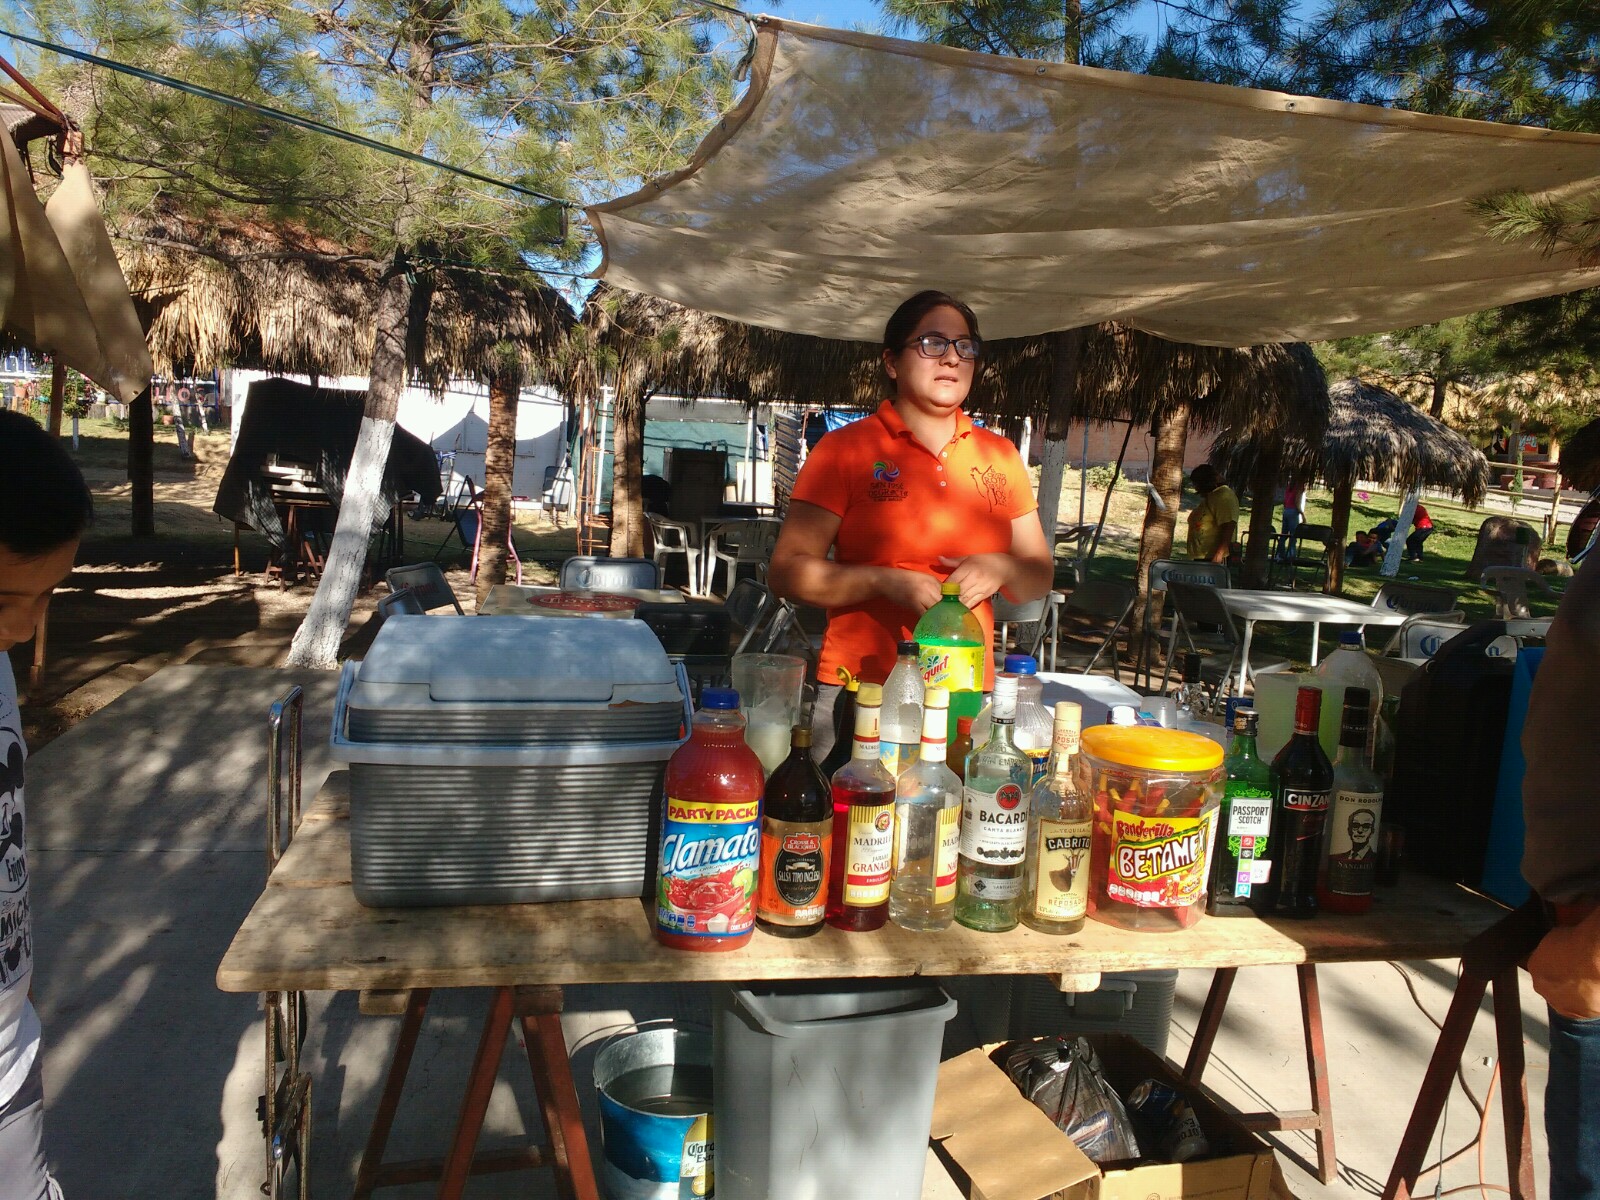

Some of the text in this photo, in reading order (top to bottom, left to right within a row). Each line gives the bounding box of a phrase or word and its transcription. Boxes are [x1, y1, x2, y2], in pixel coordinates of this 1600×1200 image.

[1339, 795, 1356, 803] DON
[669, 804, 758, 821] PARTY PACK!
[1232, 805, 1270, 816] PASSPORT
[1238, 816, 1262, 825] SCOTCH
[1116, 820, 1175, 838] Banderilla
[661, 825, 759, 876] Clamato
[1048, 838, 1091, 850] CABRITO
[687, 1142, 715, 1158] Coro
